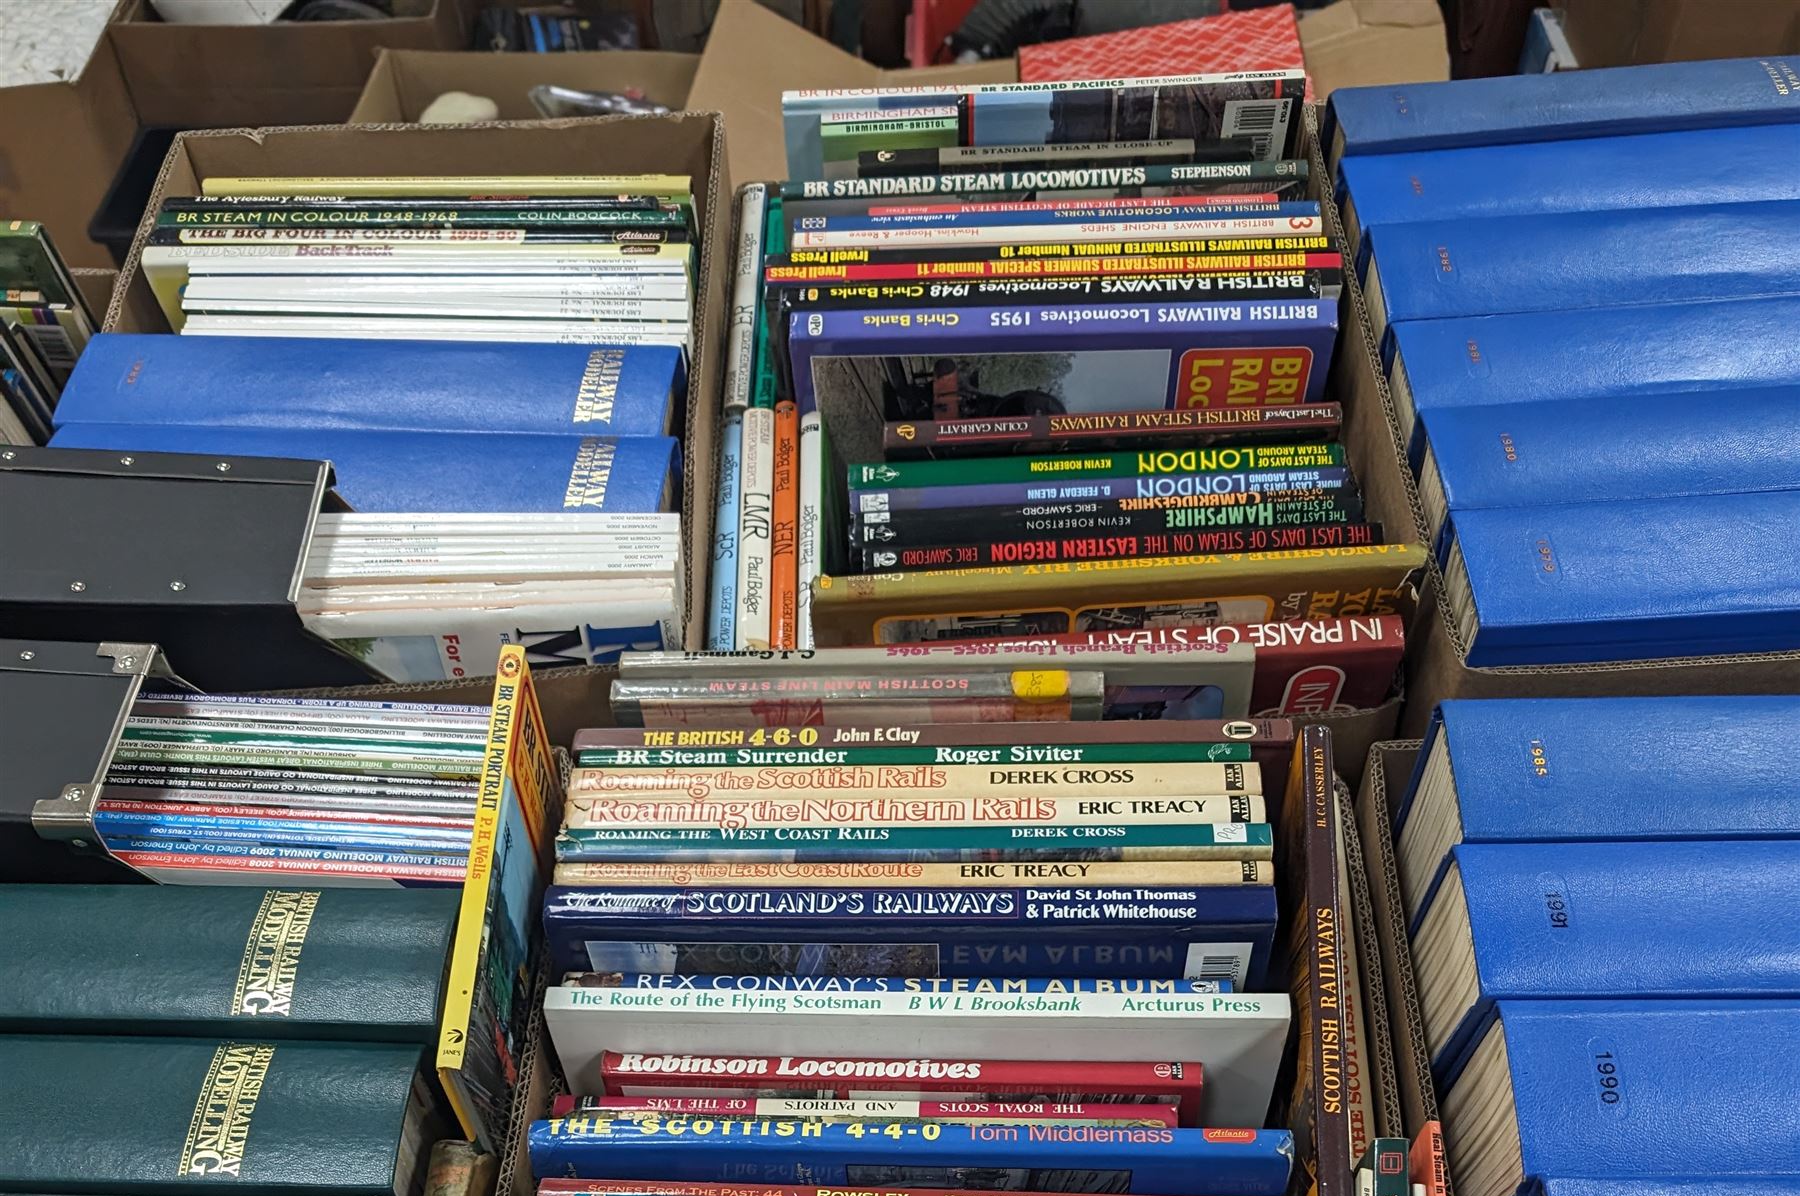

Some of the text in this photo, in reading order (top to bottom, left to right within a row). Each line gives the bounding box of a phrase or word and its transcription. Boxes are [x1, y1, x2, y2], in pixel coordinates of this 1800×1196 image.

[1002, 82, 1069, 91] STANDARD
[1073, 79, 1125, 89] PACIFICS
[1161, 75, 1203, 84] SWINGER
[982, 146, 1046, 155] STANDARD
[1051, 144, 1092, 152] STEAM
[1115, 141, 1173, 149] CLOSE-UP
[803, 164, 1251, 198] BR STANDARD STEAM LOCOMOTIVES STEPHENSON
[176, 211, 642, 222] BR STEAM IN COLOUR 1948-1968 COLIN BOOCOCK
[790, 238, 1327, 263] BRITISH RAILWAYS ILLUSTRATED ANNUAL Number 10 Irwell Press
[938, 409, 1260, 434] BRITISH STEAM RAILWAYS COLIN GARRATT
[1500, 433, 1517, 461] 1980
[1030, 459, 1111, 471] KEVIN ROBERTSON
[1137, 448, 1254, 473] LONDON
[774, 519, 794, 556] NER
[904, 525, 1373, 565] THE LAST DAYS OF STEAM ON THE EASTERN REGION ERIC SAWFORD
[743, 492, 770, 615] LMR Paul Bolger
[1537, 540, 1555, 573] 1979
[1198, 624, 1240, 644] OF
[1247, 619, 1343, 648] PRAISE
[1350, 617, 1383, 641] IN
[482, 684, 514, 811] BR STEAM PORTRAIT
[642, 727, 922, 747] THE BRITISH 4-6-0 John F. Clay
[615, 745, 1084, 766] BR Steam Surrender Roger Siviter
[1531, 738, 1547, 777] 1985
[591, 797, 1207, 828] Roaming the Northern Rails ERIC TREACY
[472, 845, 488, 881] Wells
[687, 891, 1015, 915] SCOTLAND'S RAILWAYS
[1026, 888, 1197, 901] David St John Thomas
[1026, 904, 1197, 919] & Patrick Whitehouse
[242, 890, 302, 1015] MODELLING
[273, 891, 321, 1016] BRITISH RAILWAY
[570, 990, 1261, 1013] The Route of the Flying Scotsman B W L Brooksbank Arcturus Press
[1315, 908, 1341, 1114] SCOTTISH RAILWAYS
[617, 1053, 982, 1080] Robinson Locomotives
[1595, 1051, 1620, 1105] 1990
[548, 1119, 1174, 1144] THE 'SCOTTISH' 4-4-0 Tom Middlemass
